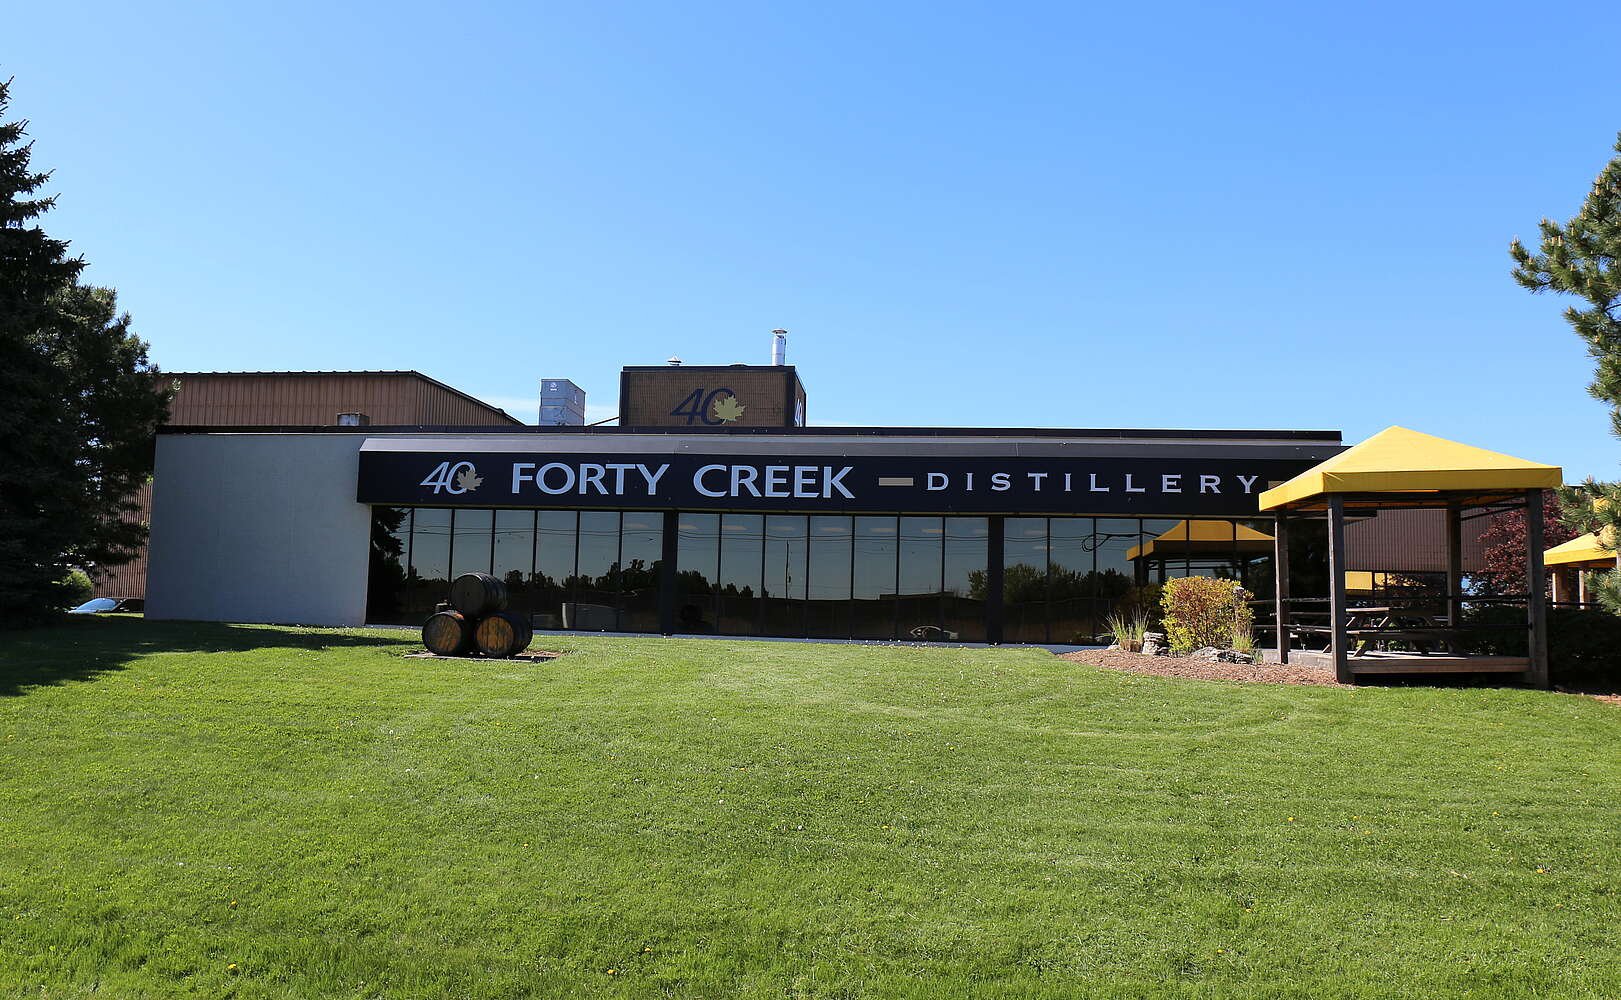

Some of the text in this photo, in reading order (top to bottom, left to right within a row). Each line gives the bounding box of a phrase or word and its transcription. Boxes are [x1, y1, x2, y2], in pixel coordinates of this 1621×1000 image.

[511, 462, 671, 496] FORTY
[692, 464, 856, 499] CREEK
[926, 472, 1259, 494] DISTILLERY
